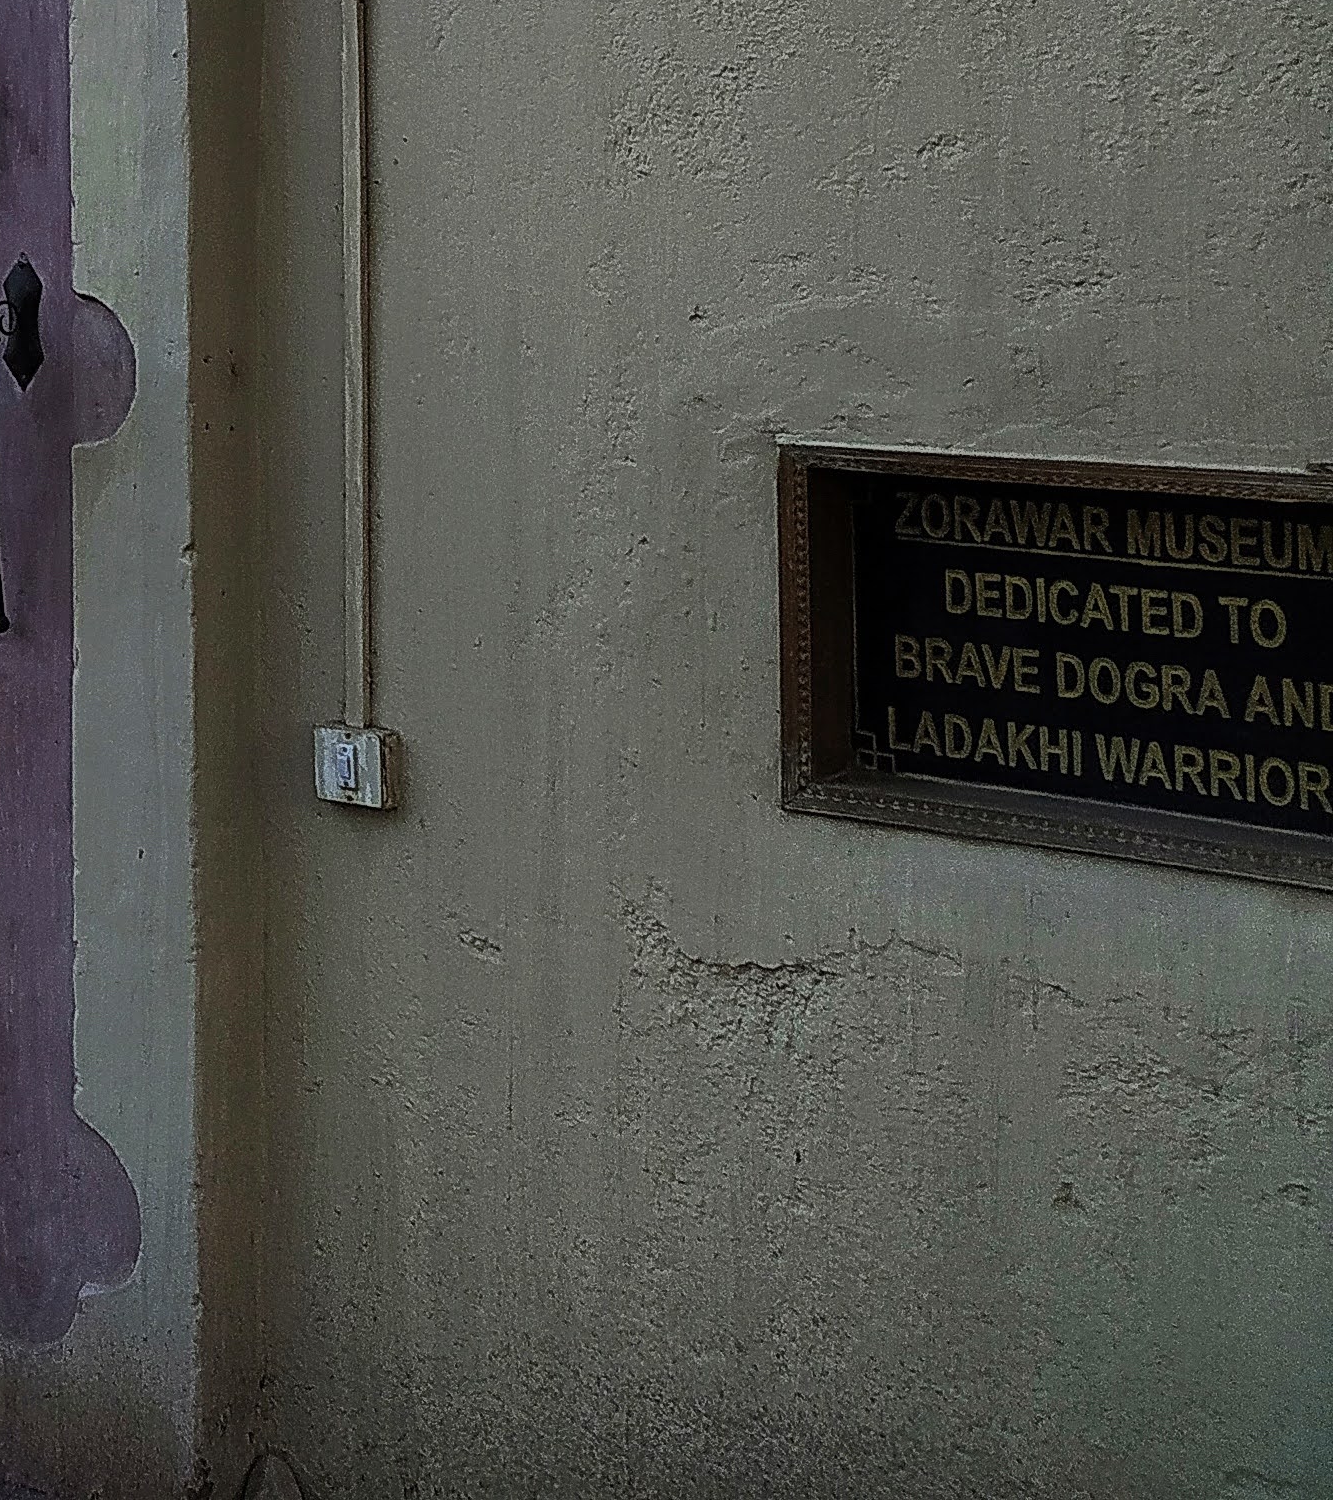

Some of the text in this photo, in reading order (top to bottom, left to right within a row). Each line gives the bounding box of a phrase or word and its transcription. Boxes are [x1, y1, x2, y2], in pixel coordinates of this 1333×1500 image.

[894, 491, 1333, 574] ZORAWAR MUSEUM
[944, 568, 1288, 649] DEDICATED TO
[894, 634, 1041, 695] BRAVE
[1055, 651, 1231, 719] DOGRA
[887, 705, 1333, 815] LADAKHI WARRIOR
